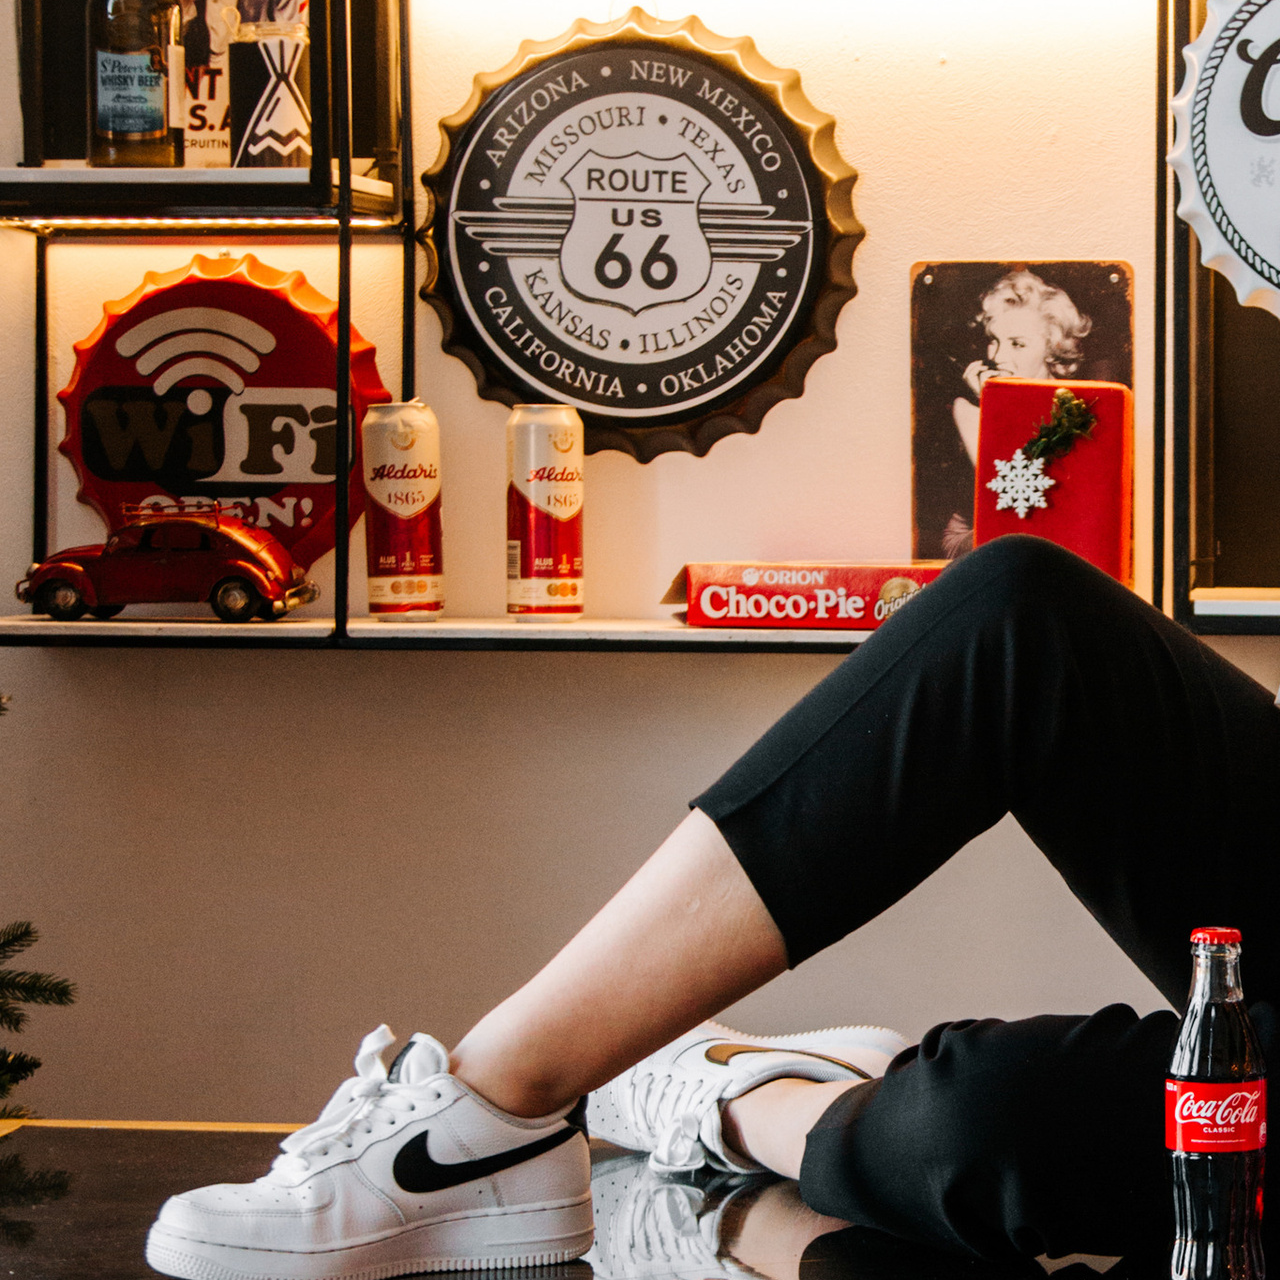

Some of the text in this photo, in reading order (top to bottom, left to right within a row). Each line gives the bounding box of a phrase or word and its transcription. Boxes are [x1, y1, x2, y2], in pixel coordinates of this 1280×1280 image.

[137, 75, 163, 88] BEER
[484, 59, 782, 173] ARIZONA NEW MEXICO
[523, 105, 746, 196] MISSOURI TEXAS
[586, 167, 688, 194] ROUTE
[610, 207, 663, 228] US
[593, 232, 679, 292] 66
[523, 267, 745, 355] KANSAS ILLINOIS
[483, 284, 788, 399] CALIFORNIA OKLAHOMA
[370, 464, 438, 481] Aldaris
[387, 490, 426, 506] 1865
[763, 569, 824, 585] ORION
[1174, 1090, 1261, 1126] Coca-Cola
[1202, 1126, 1236, 1134] CLASSIC
